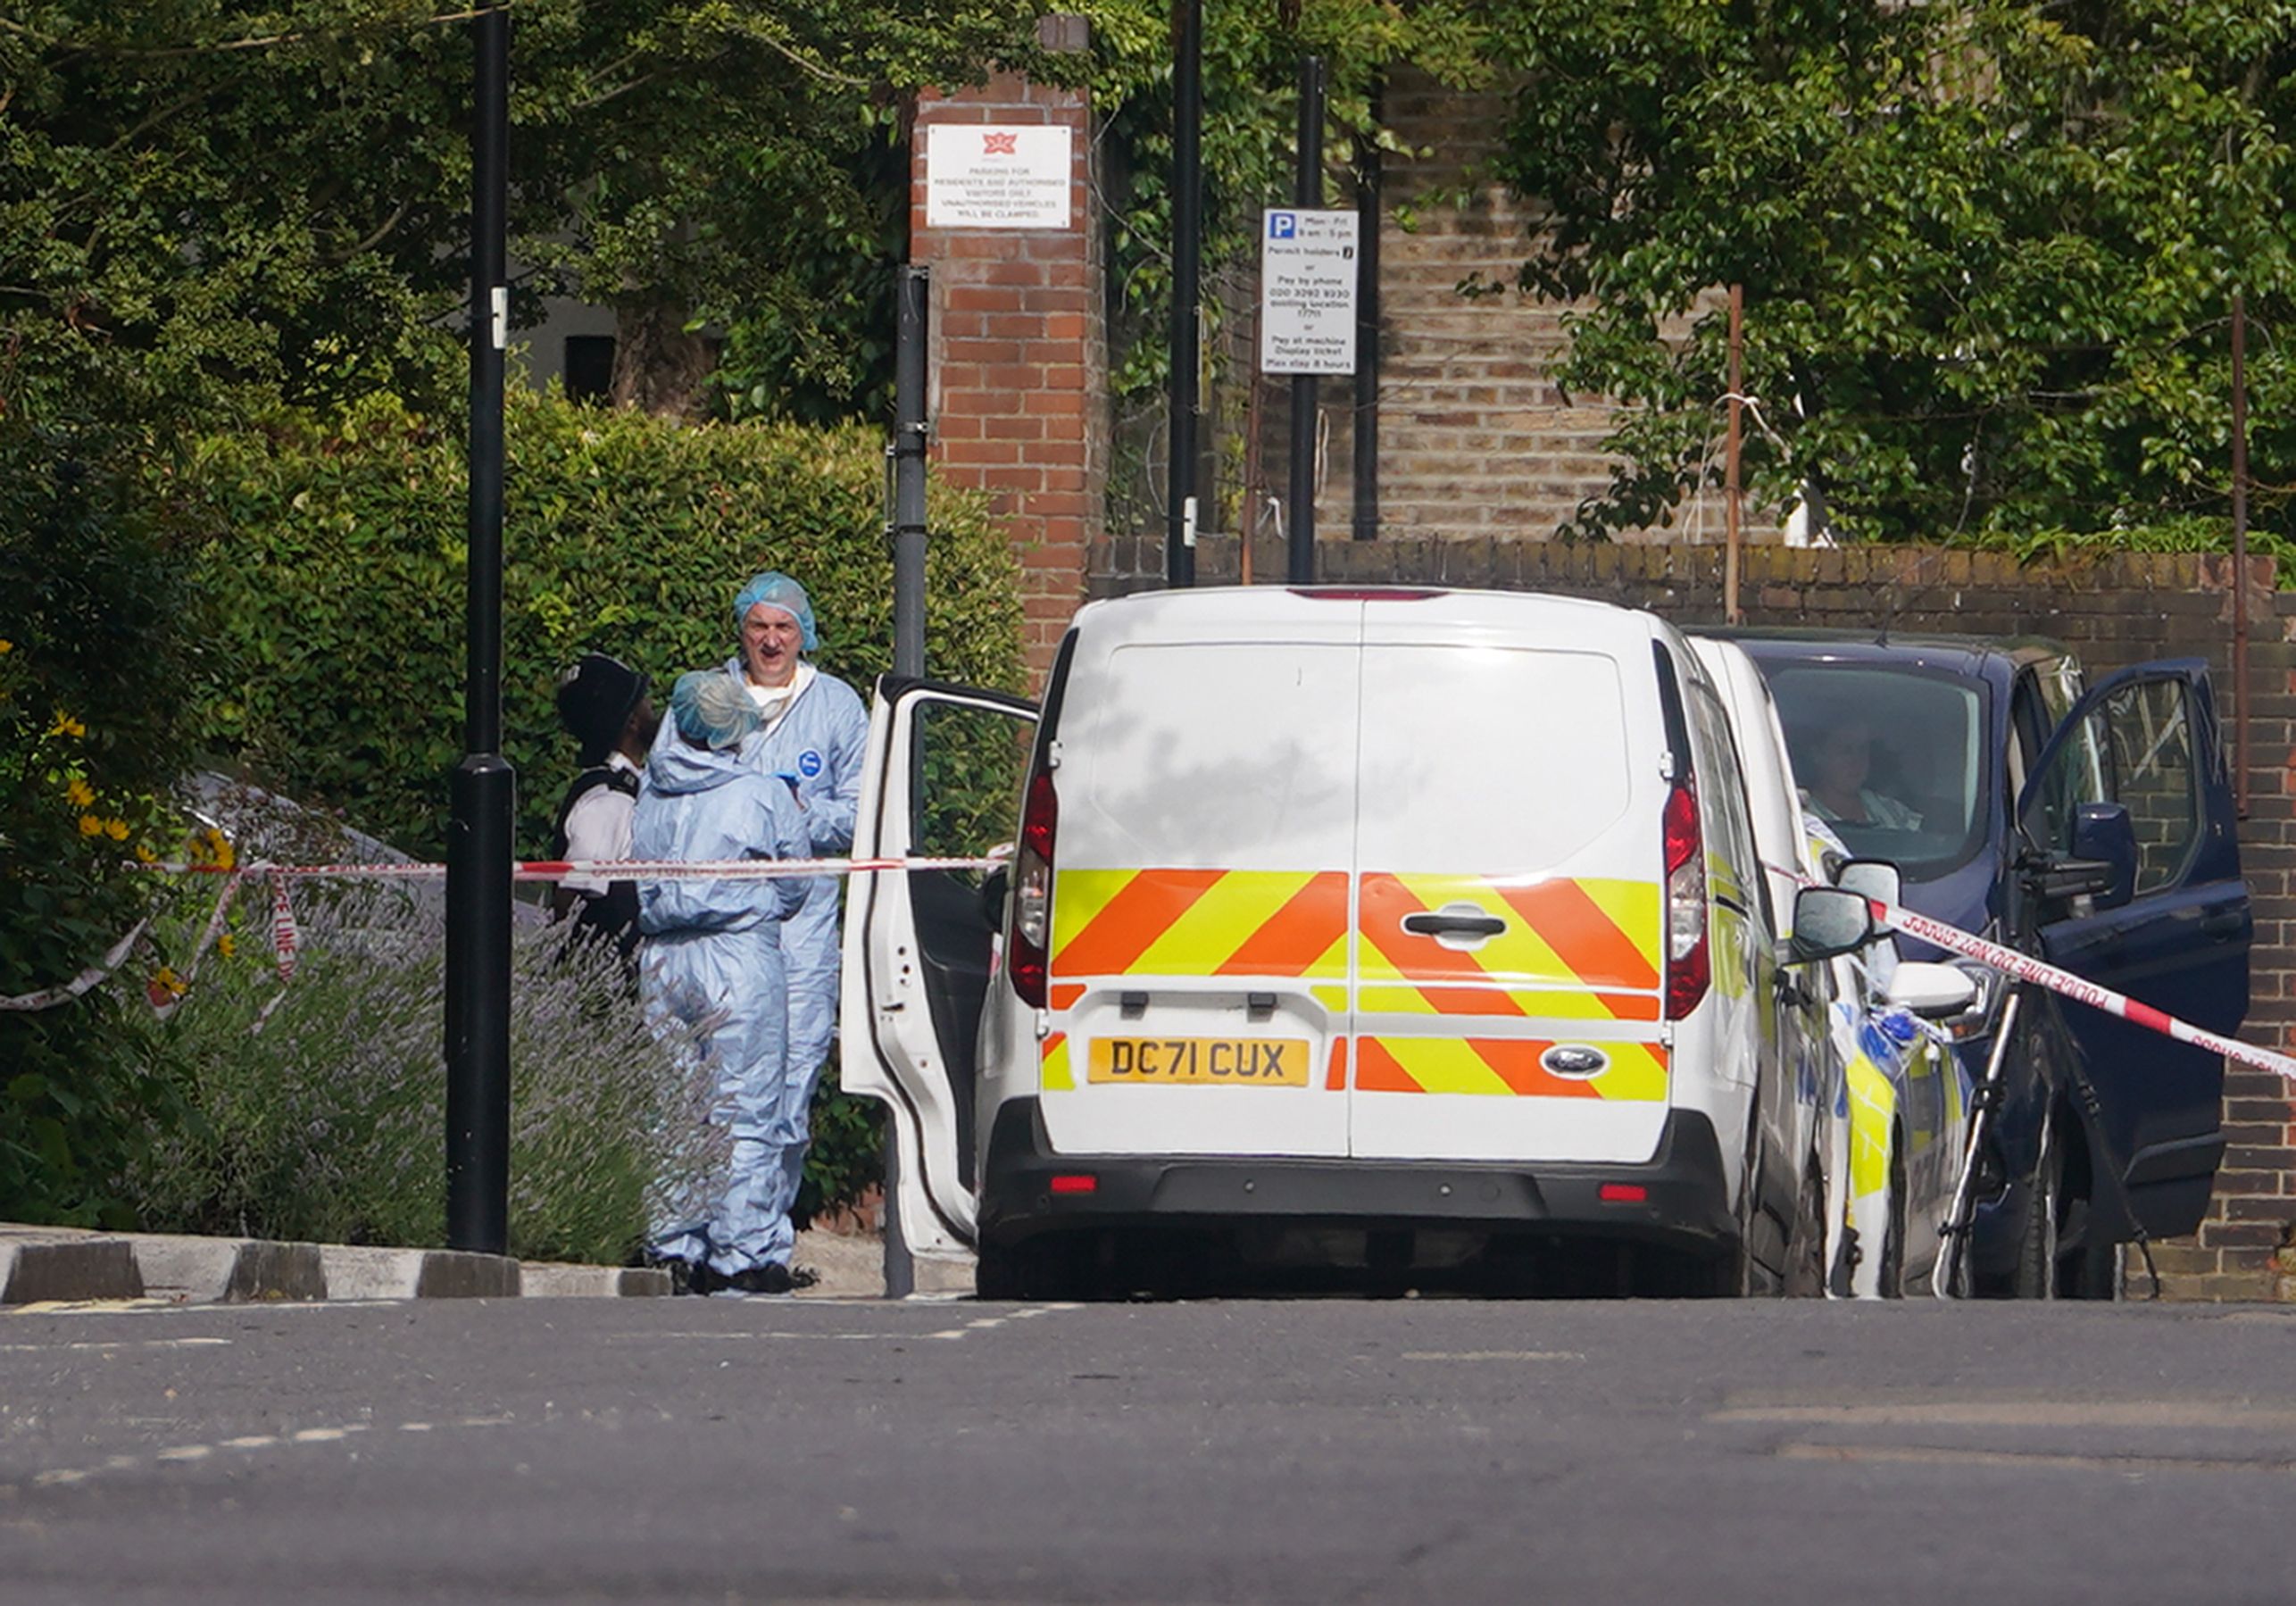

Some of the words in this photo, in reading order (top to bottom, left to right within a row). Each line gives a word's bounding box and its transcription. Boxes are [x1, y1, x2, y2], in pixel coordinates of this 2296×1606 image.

[969, 167, 1009, 175] PARKING
[1011, 167, 1030, 175] FOR
[934, 178, 983, 187] RESIDENTS
[987, 178, 1005, 187] AND
[1008, 178, 1067, 187] AUTHORISED
[965, 189, 1005, 197] VISITORS
[941, 199, 1011, 208] UNAUTHORISED
[1013, 200, 1057, 208] VEHICLES
[957, 210, 978, 218] WILL
[1274, 215, 1294, 237] P
[1304, 217, 1326, 225] Mon
[1337, 229, 1352, 239] pm
[1268, 245, 1301, 255] Permit
[1303, 246, 1341, 257] holders
[1277, 275, 1295, 286] Pay
[1299, 276, 1310, 287] by
[1313, 277, 1343, 286] phone
[1309, 299, 1351, 309] location
[1271, 335, 1290, 345] Pay
[1305, 337, 1346, 345] machine
[1275, 345, 1310, 355] Display
[1313, 346, 1343, 355] ticket
[1265, 359, 1286, 367] Max
[1289, 359, 1310, 369] stay
[1323, 359, 1352, 370] hours
[275, 917, 296, 953] LINE
[1956, 937, 1992, 961] NOT
[1989, 951, 2018, 972] DO
[2016, 961, 2052, 984] LINE
[1111, 1040, 1198, 1076] DC71
[1209, 1042, 1285, 1078] CUX
